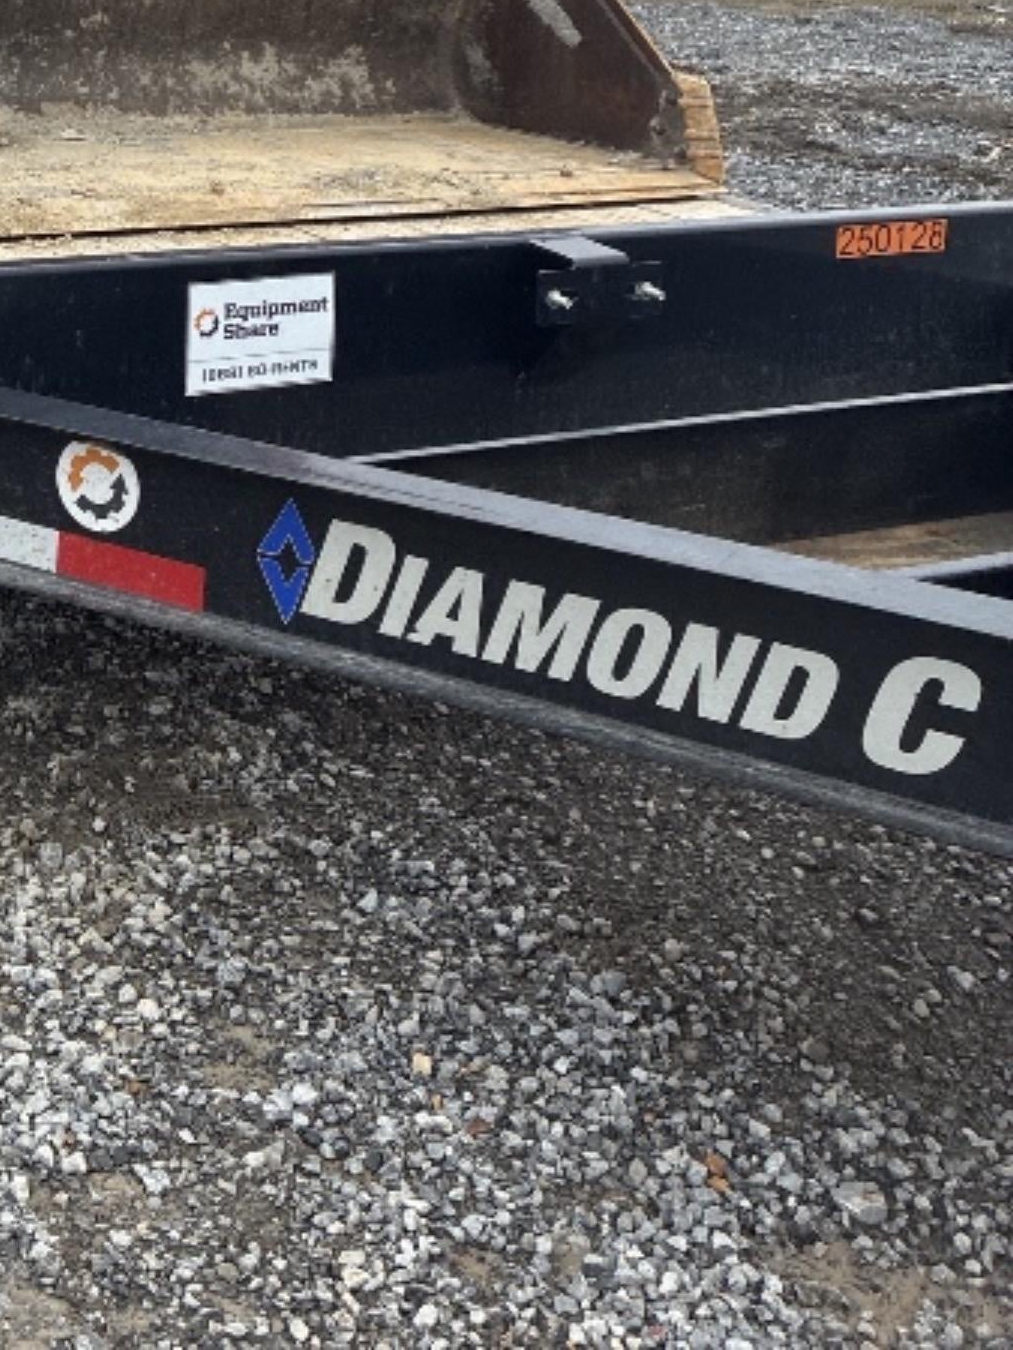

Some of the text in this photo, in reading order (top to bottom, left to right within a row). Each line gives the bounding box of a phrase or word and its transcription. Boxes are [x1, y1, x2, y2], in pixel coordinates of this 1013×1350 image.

[839, 220, 943, 256] 250128
[224, 296, 328, 321] Equipment
[223, 322, 280, 340] Share
[862, 655, 982, 776] C
